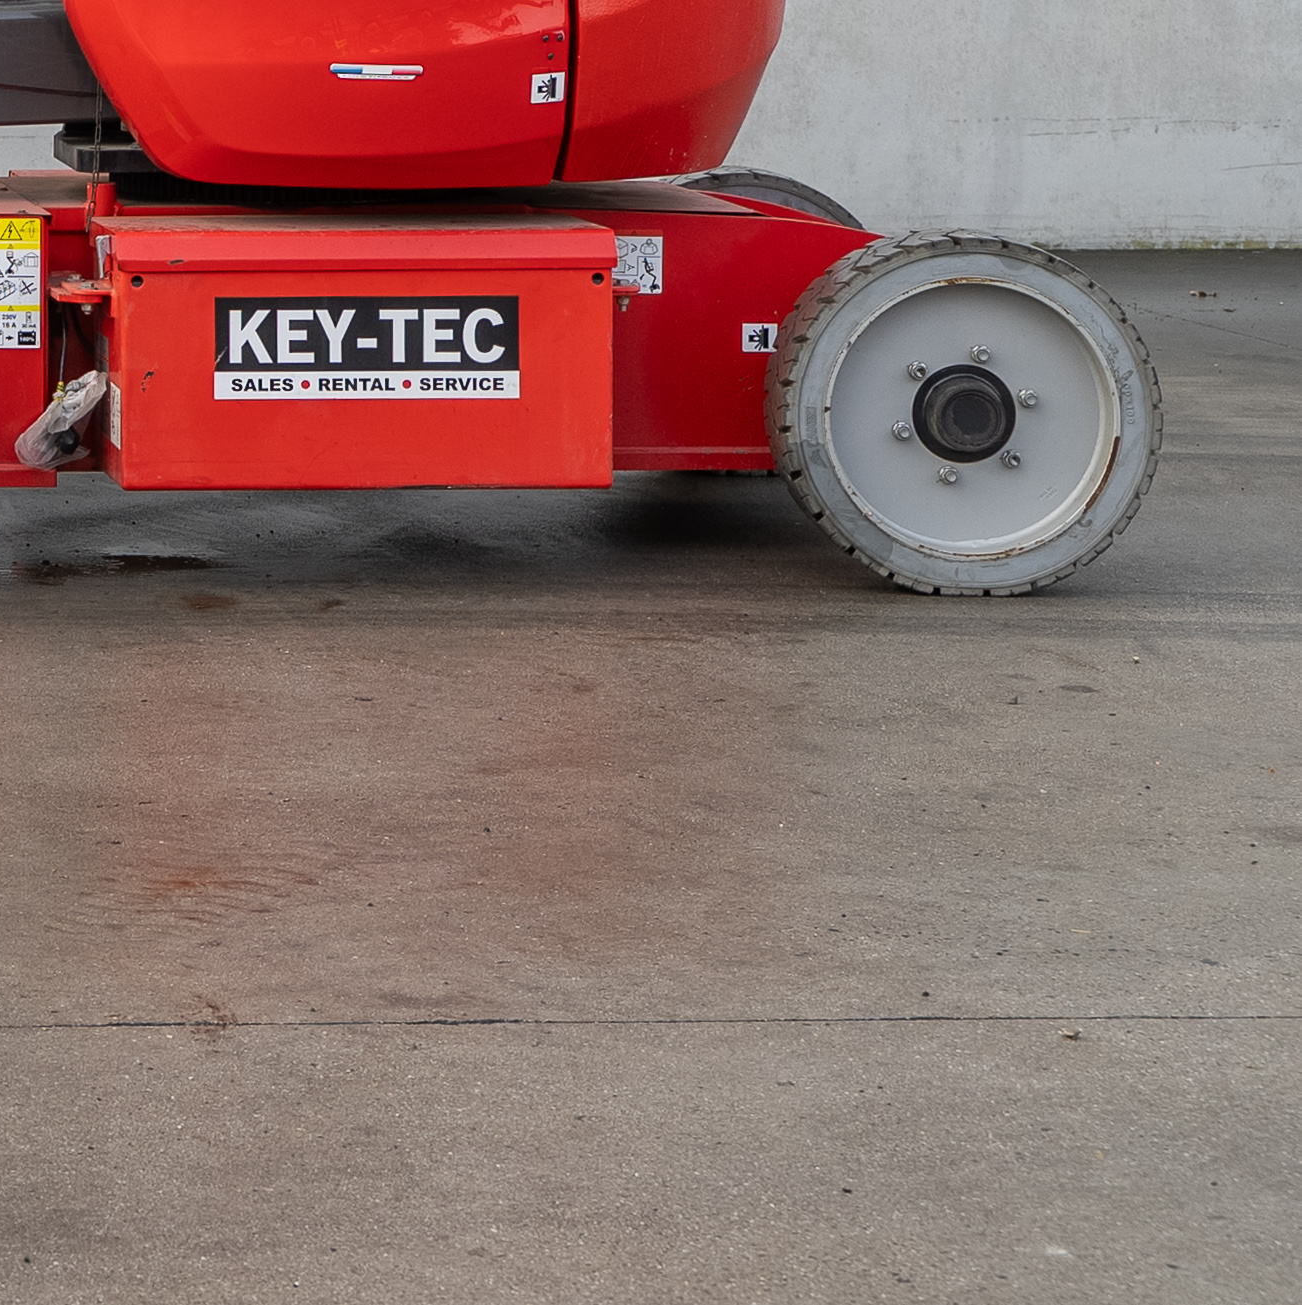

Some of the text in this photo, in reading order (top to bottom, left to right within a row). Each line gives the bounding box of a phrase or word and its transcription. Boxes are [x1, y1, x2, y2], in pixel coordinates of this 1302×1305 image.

[228, 308, 505, 364] KEY-TEC
[231, 377, 505, 392] SALES RENTAL SERVICE
